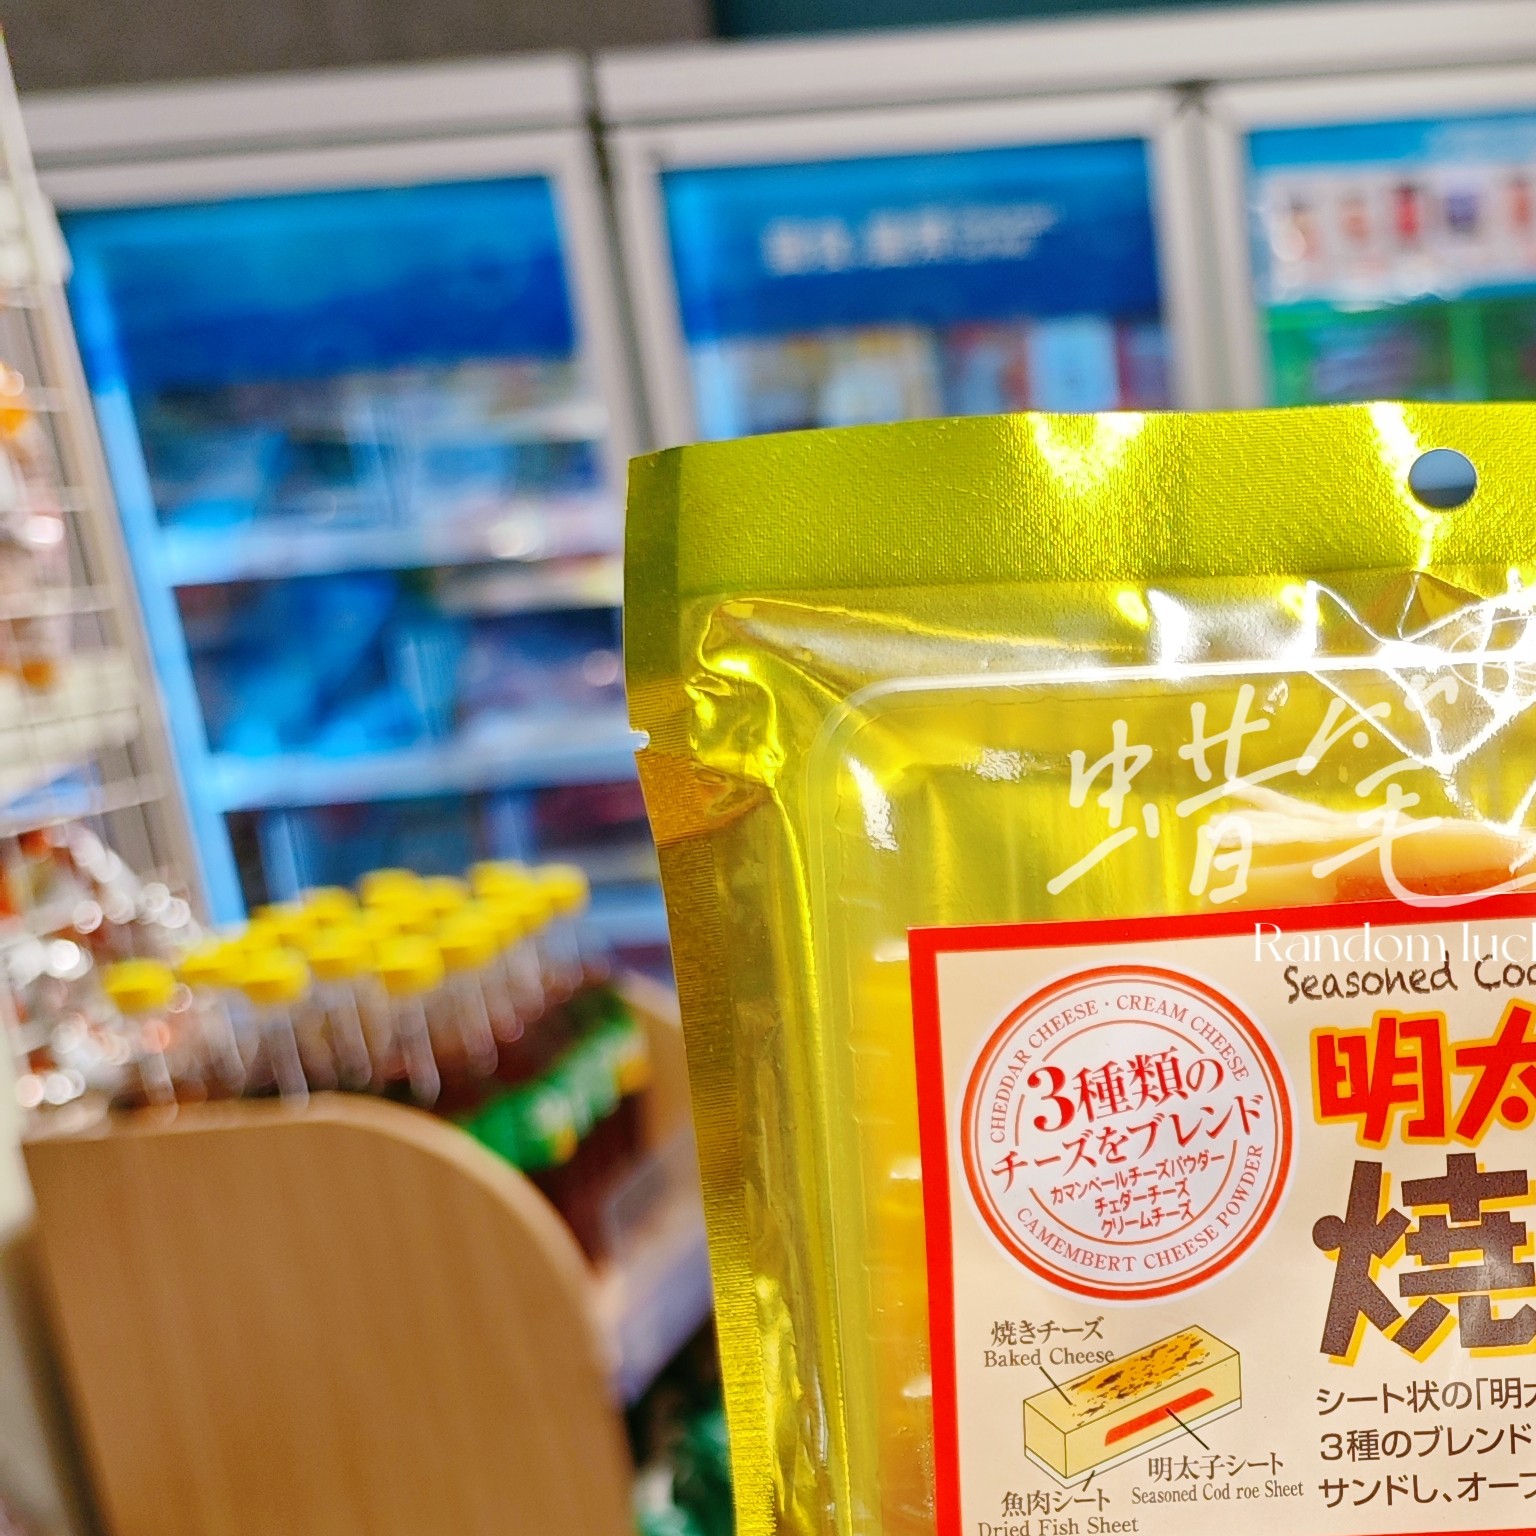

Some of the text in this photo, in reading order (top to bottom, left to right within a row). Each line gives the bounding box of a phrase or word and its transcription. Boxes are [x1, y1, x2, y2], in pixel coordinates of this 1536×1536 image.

[1284, 949, 1459, 1004] Seasoned
[989, 993, 1250, 1145] CHEDDAR CHEESE CREAM CHEESE
[1026, 1045, 1225, 1134] 3種類の
[990, 1093, 1265, 1194] チーズをブレンド
[1049, 1150, 1227, 1206] カマンベールチーズパウダー
[1094, 1177, 1192, 1219] チェダーチーズ
[1016, 1143, 1265, 1273] CAMEMBERT CHEESE POWDER
[1100, 1199, 1194, 1239] クリームチーズ
[990, 1316, 1105, 1348] 焼きチーズ
[983, 1346, 1116, 1368] Baked Cheese
[1147, 1452, 1284, 1483] 明太子シート
[1000, 1487, 1111, 1519] 魚肉シート
[1131, 1480, 1305, 1506] Seasoned Cod roe Sheet
[1038, 1517, 1081, 1536] Fish
[1086, 1514, 1140, 1535] Sheet
